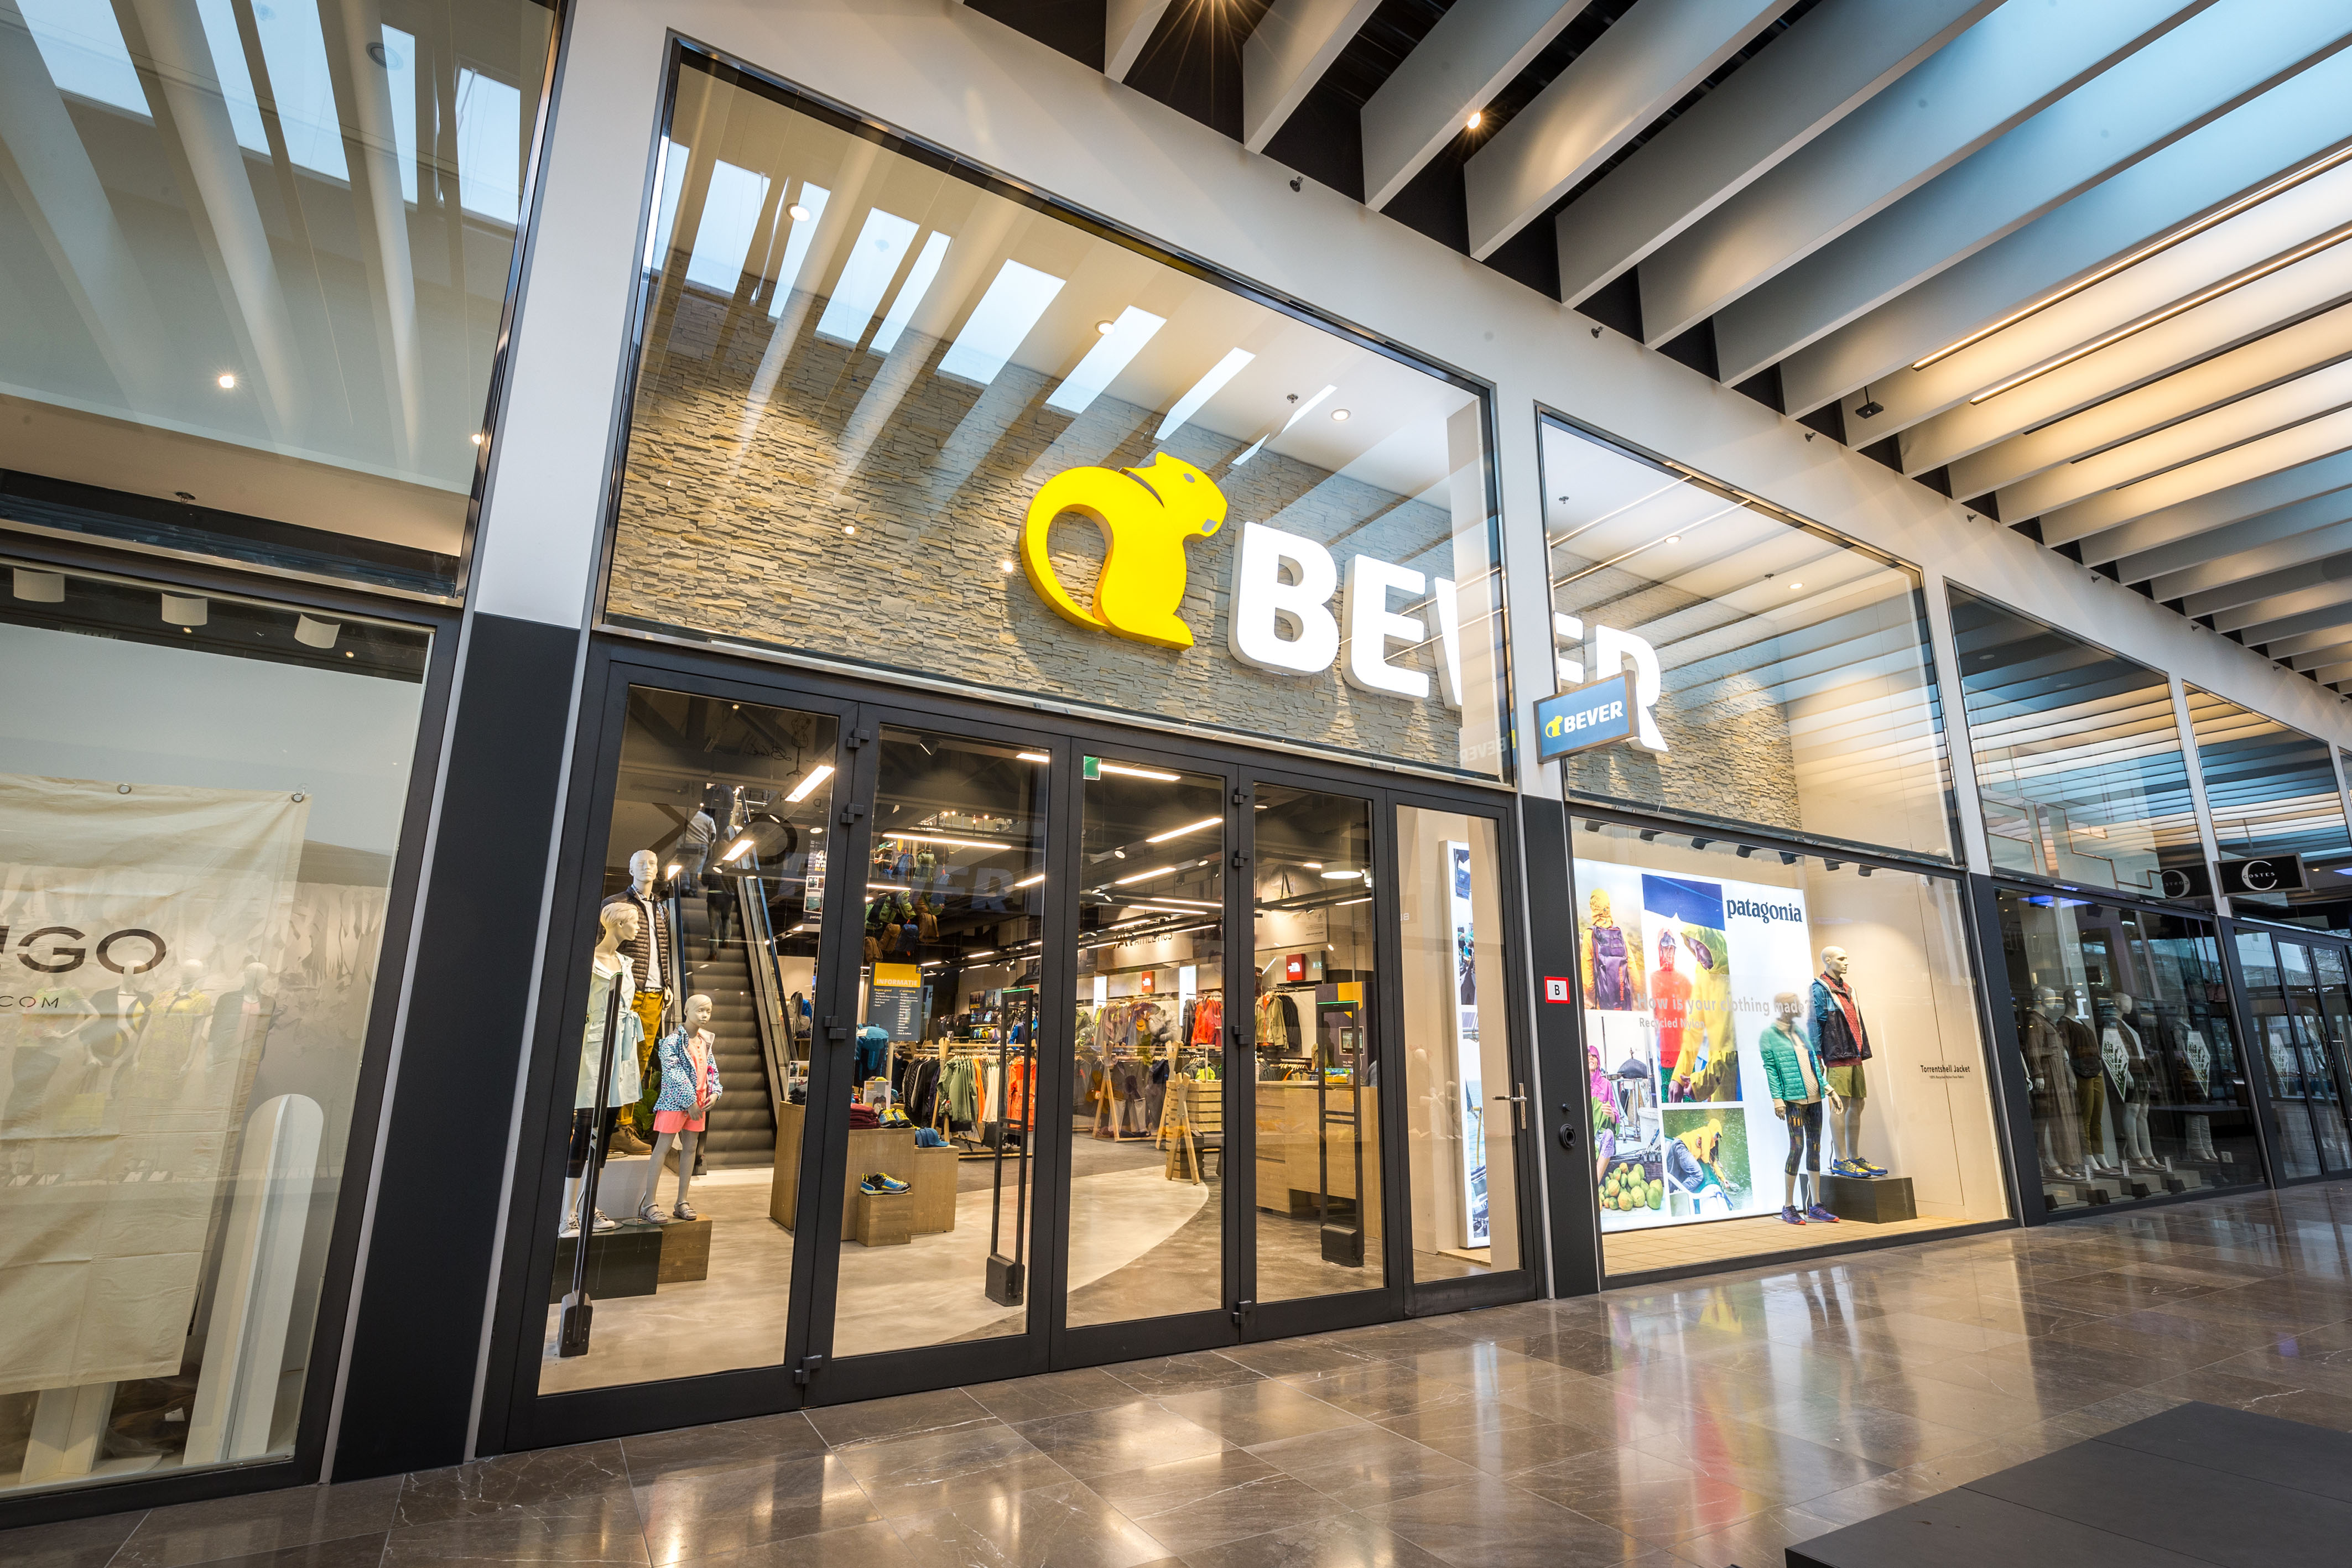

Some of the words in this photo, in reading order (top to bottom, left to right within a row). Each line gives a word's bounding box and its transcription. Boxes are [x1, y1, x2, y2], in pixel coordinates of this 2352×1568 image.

[1564, 700, 1623, 733] BEVER
[1726, 899, 1802, 924] patagonia
[1554, 984, 1560, 996] B
[1637, 993, 1668, 1010] How
[1673, 994, 1683, 1010] is
[1686, 998, 1716, 1014] your
[1720, 997, 1770, 1017] clothing
[1640, 1017, 1678, 1030] Recycled
[1680, 1018, 1705, 1032] Nylon
[1920, 1065, 1953, 1073] Torrentshell
